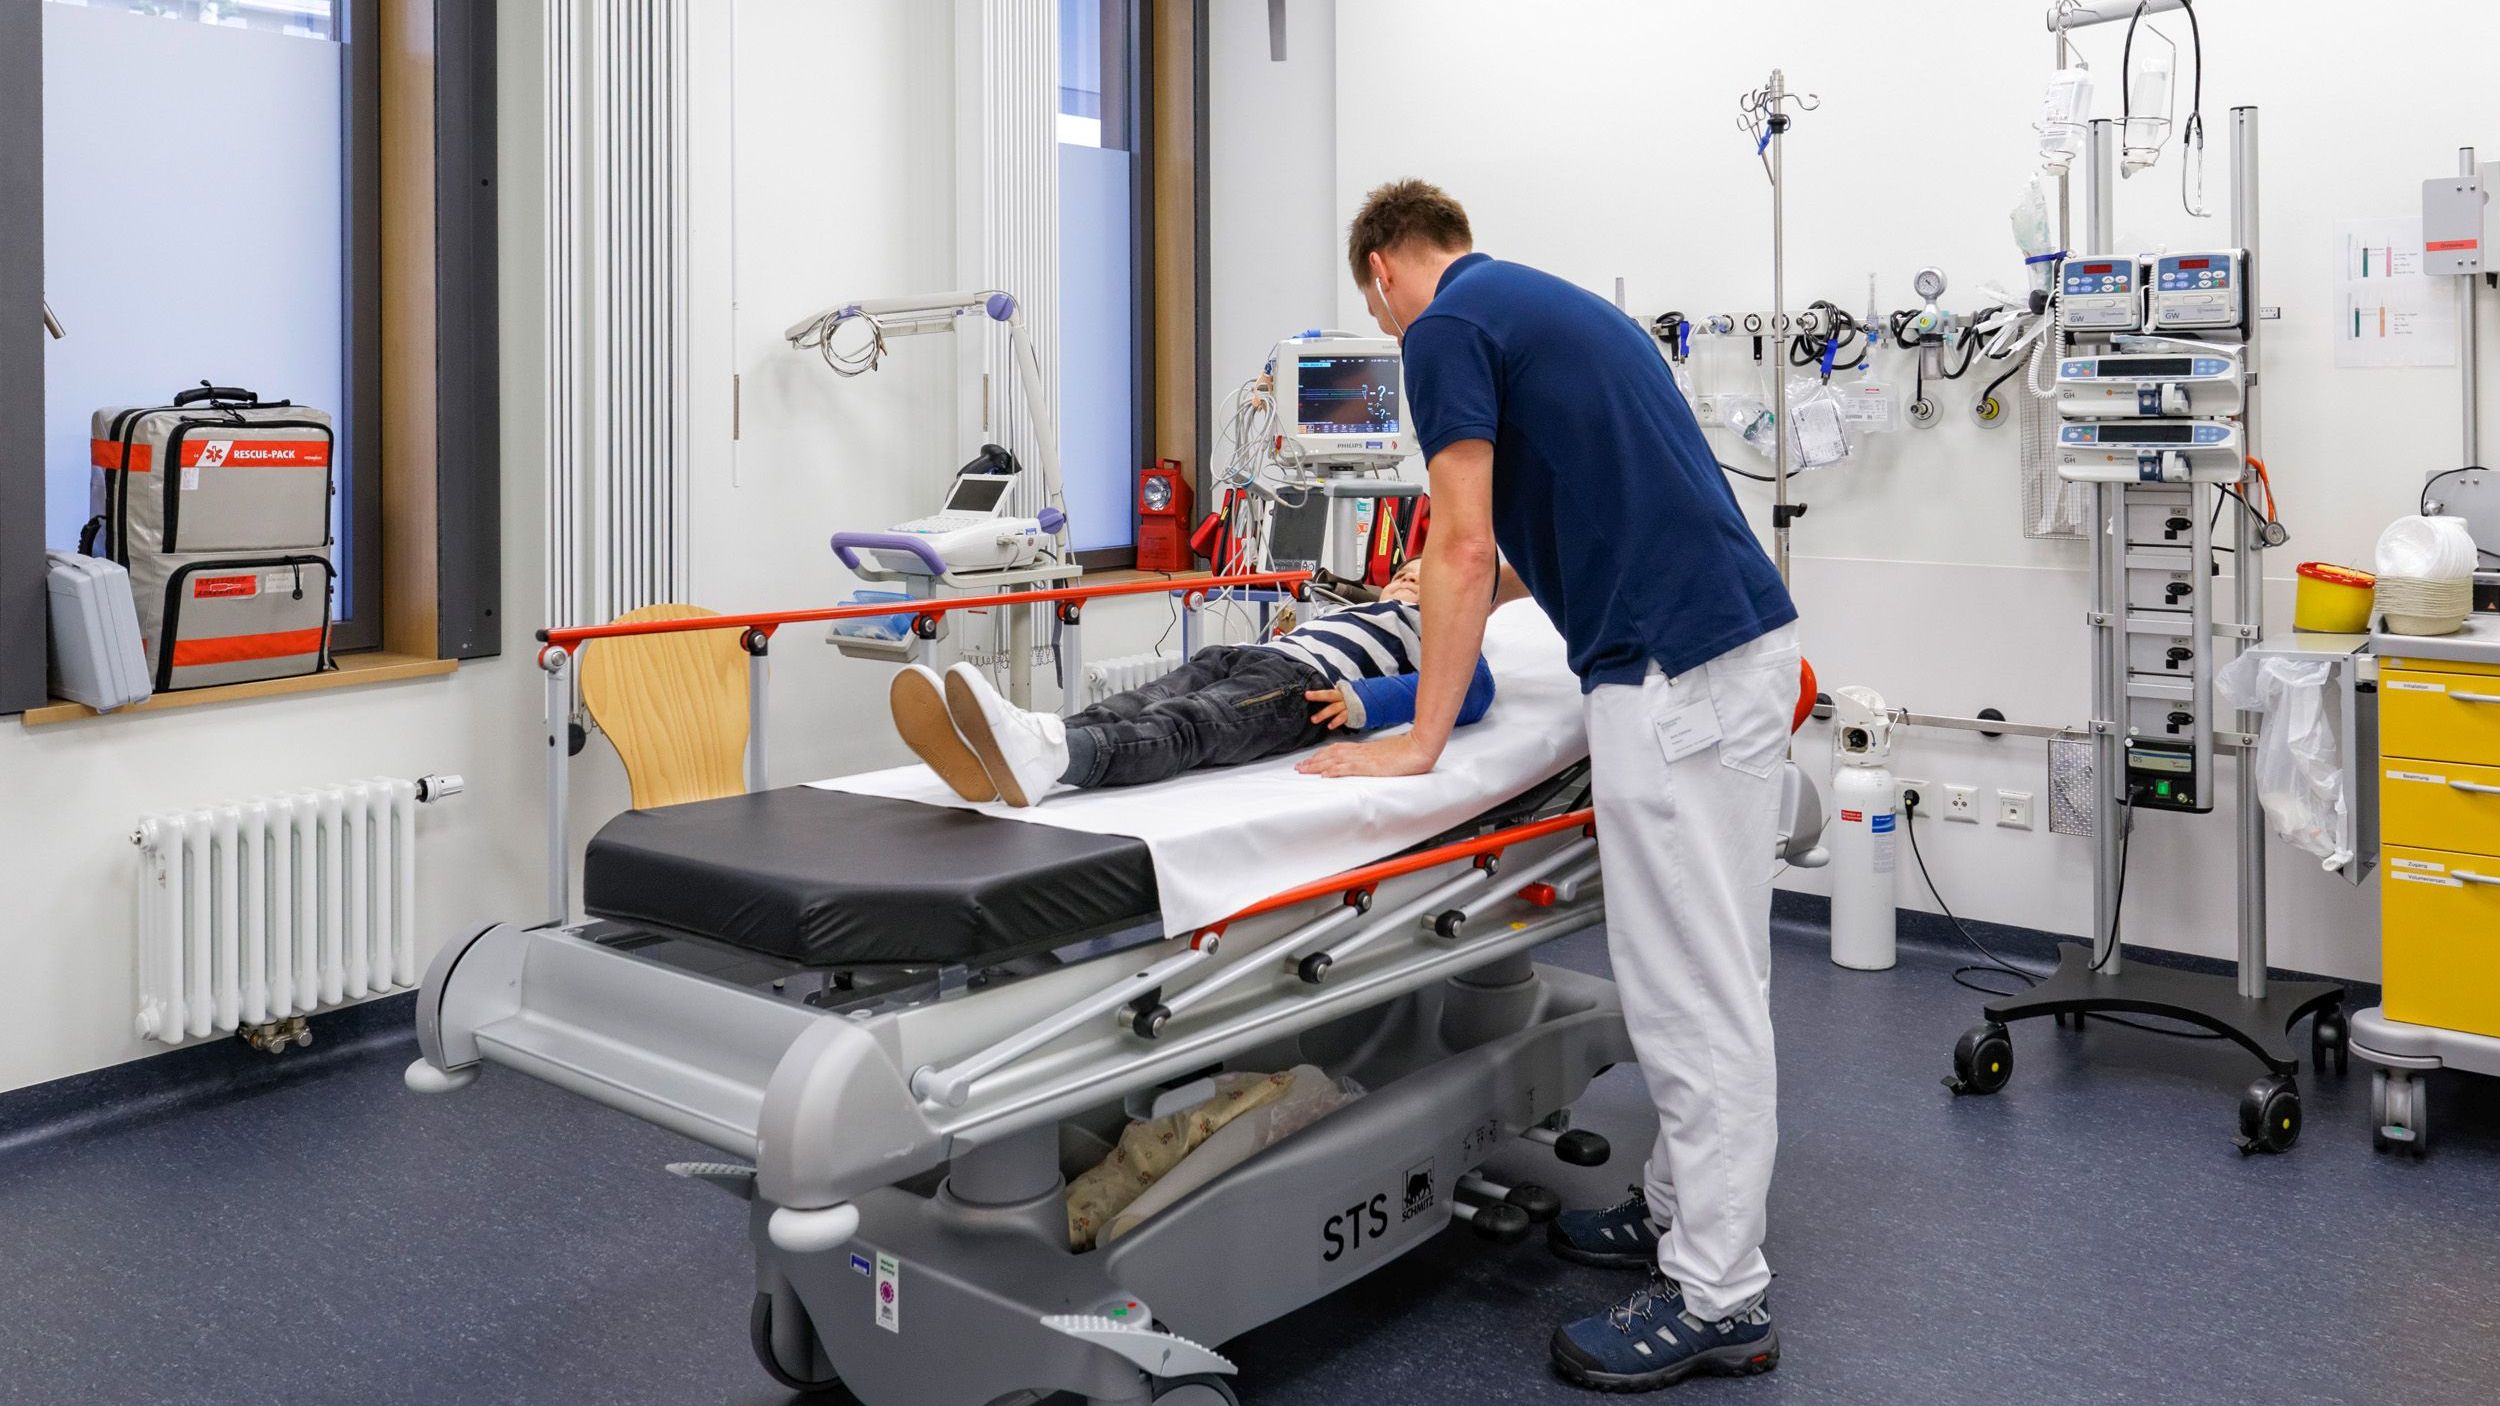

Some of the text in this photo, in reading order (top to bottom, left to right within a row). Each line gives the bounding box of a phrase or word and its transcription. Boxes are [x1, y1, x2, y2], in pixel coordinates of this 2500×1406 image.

[2070, 315, 2084, 323] GW
[2165, 312, 2180, 320] GW
[233, 449, 296, 459] RESCUE-PACK
[1402, 1195, 1434, 1223] SCHMITZ
[1323, 1193, 1388, 1262] STS
